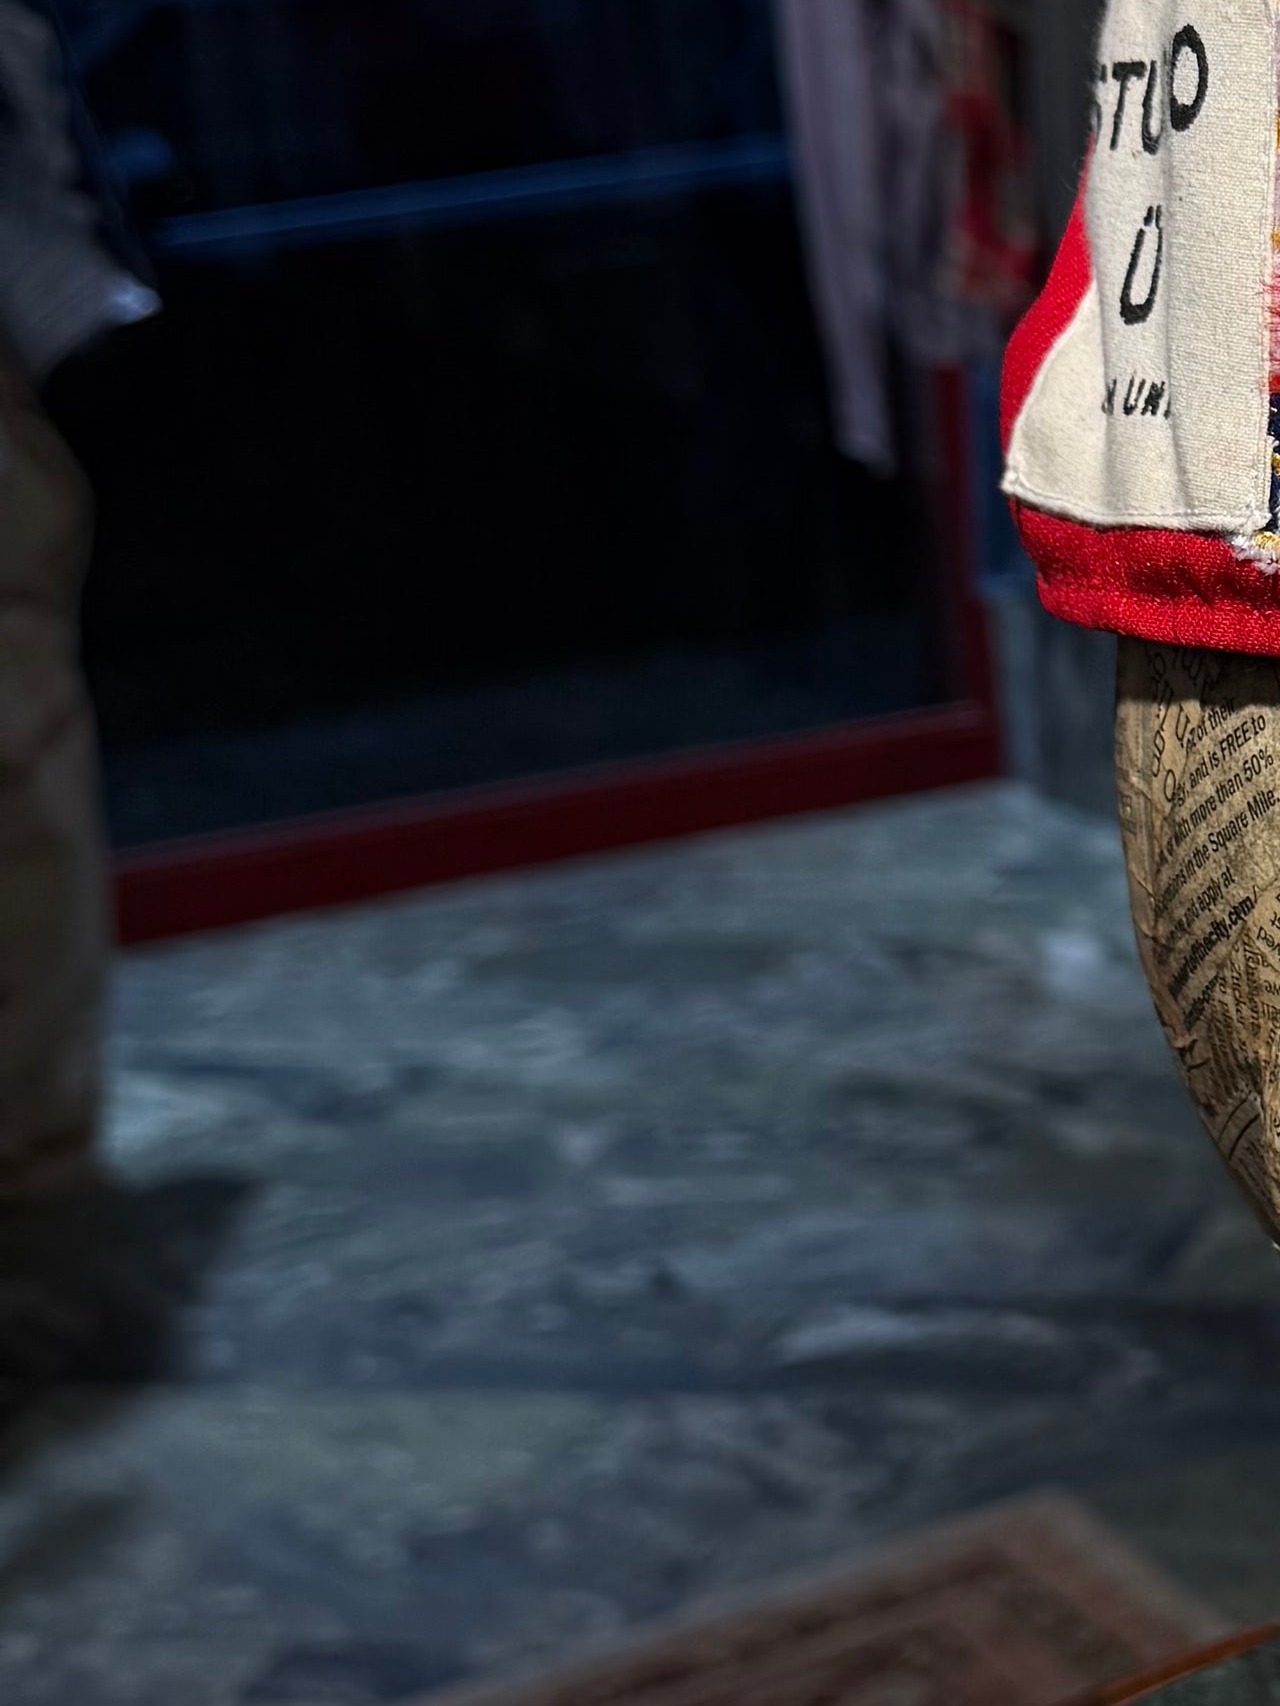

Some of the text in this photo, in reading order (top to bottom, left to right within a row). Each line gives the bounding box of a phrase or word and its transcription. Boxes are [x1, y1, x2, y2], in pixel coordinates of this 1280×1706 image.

[1219, 726, 1250, 764] FREE
[1189, 745, 1276, 829] more than 50%
[1207, 813, 1250, 855] Square
